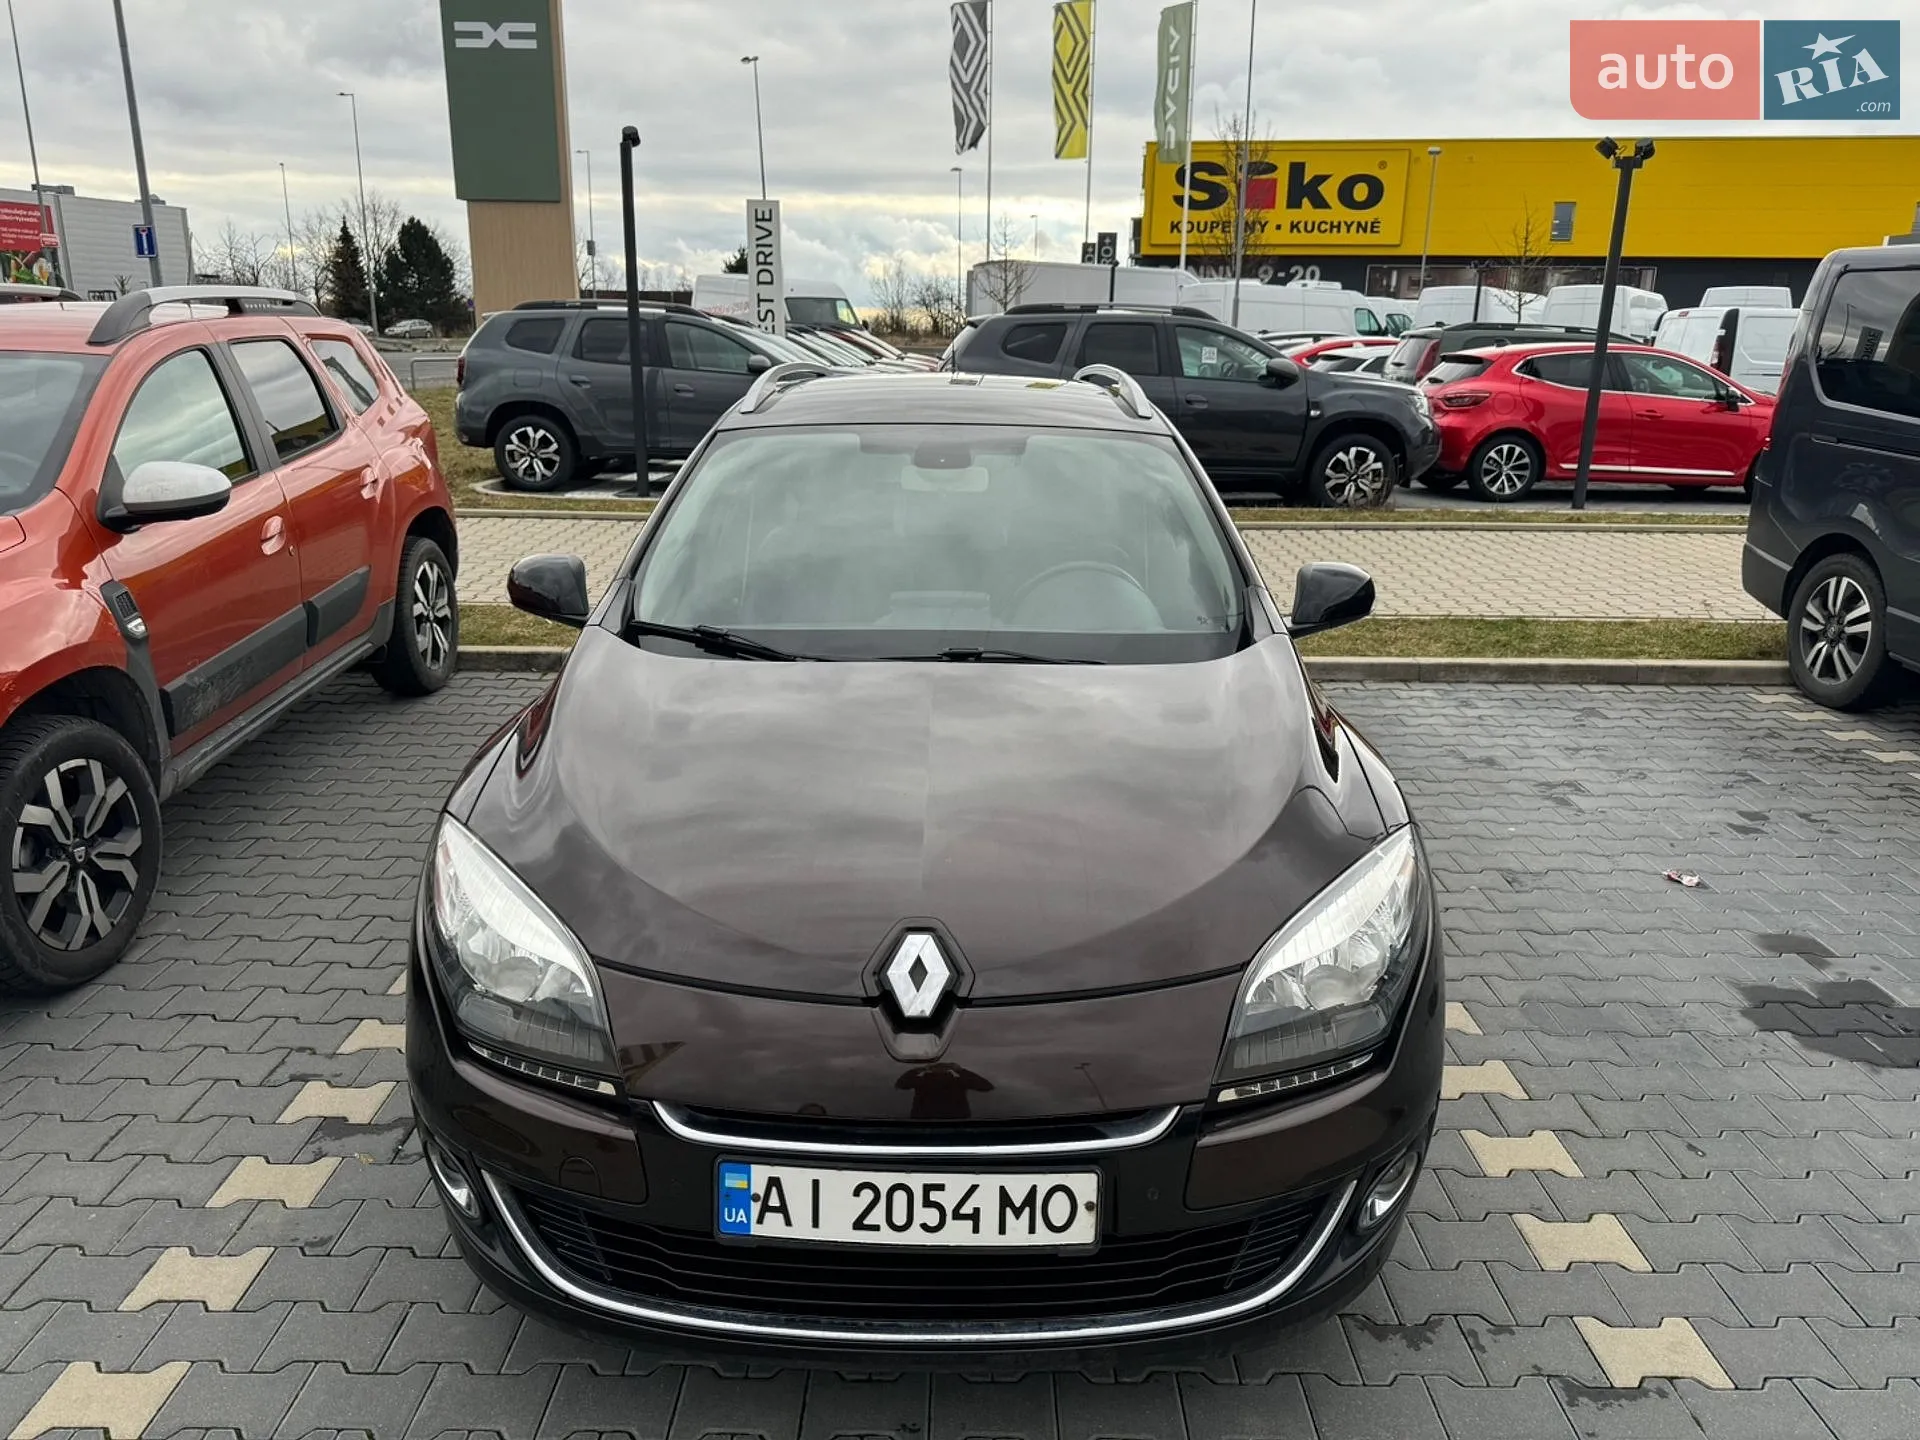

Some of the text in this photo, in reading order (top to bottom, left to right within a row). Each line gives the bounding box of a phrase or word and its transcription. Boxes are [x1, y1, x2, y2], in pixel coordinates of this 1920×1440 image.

[1169, 217, 1382, 235] KOUPENY KUCHYNĚ
[754, 208, 774, 286] DRIVE
[724, 1207, 748, 1225] UA
[755, 1175, 1079, 1236] AI 2054 MO
